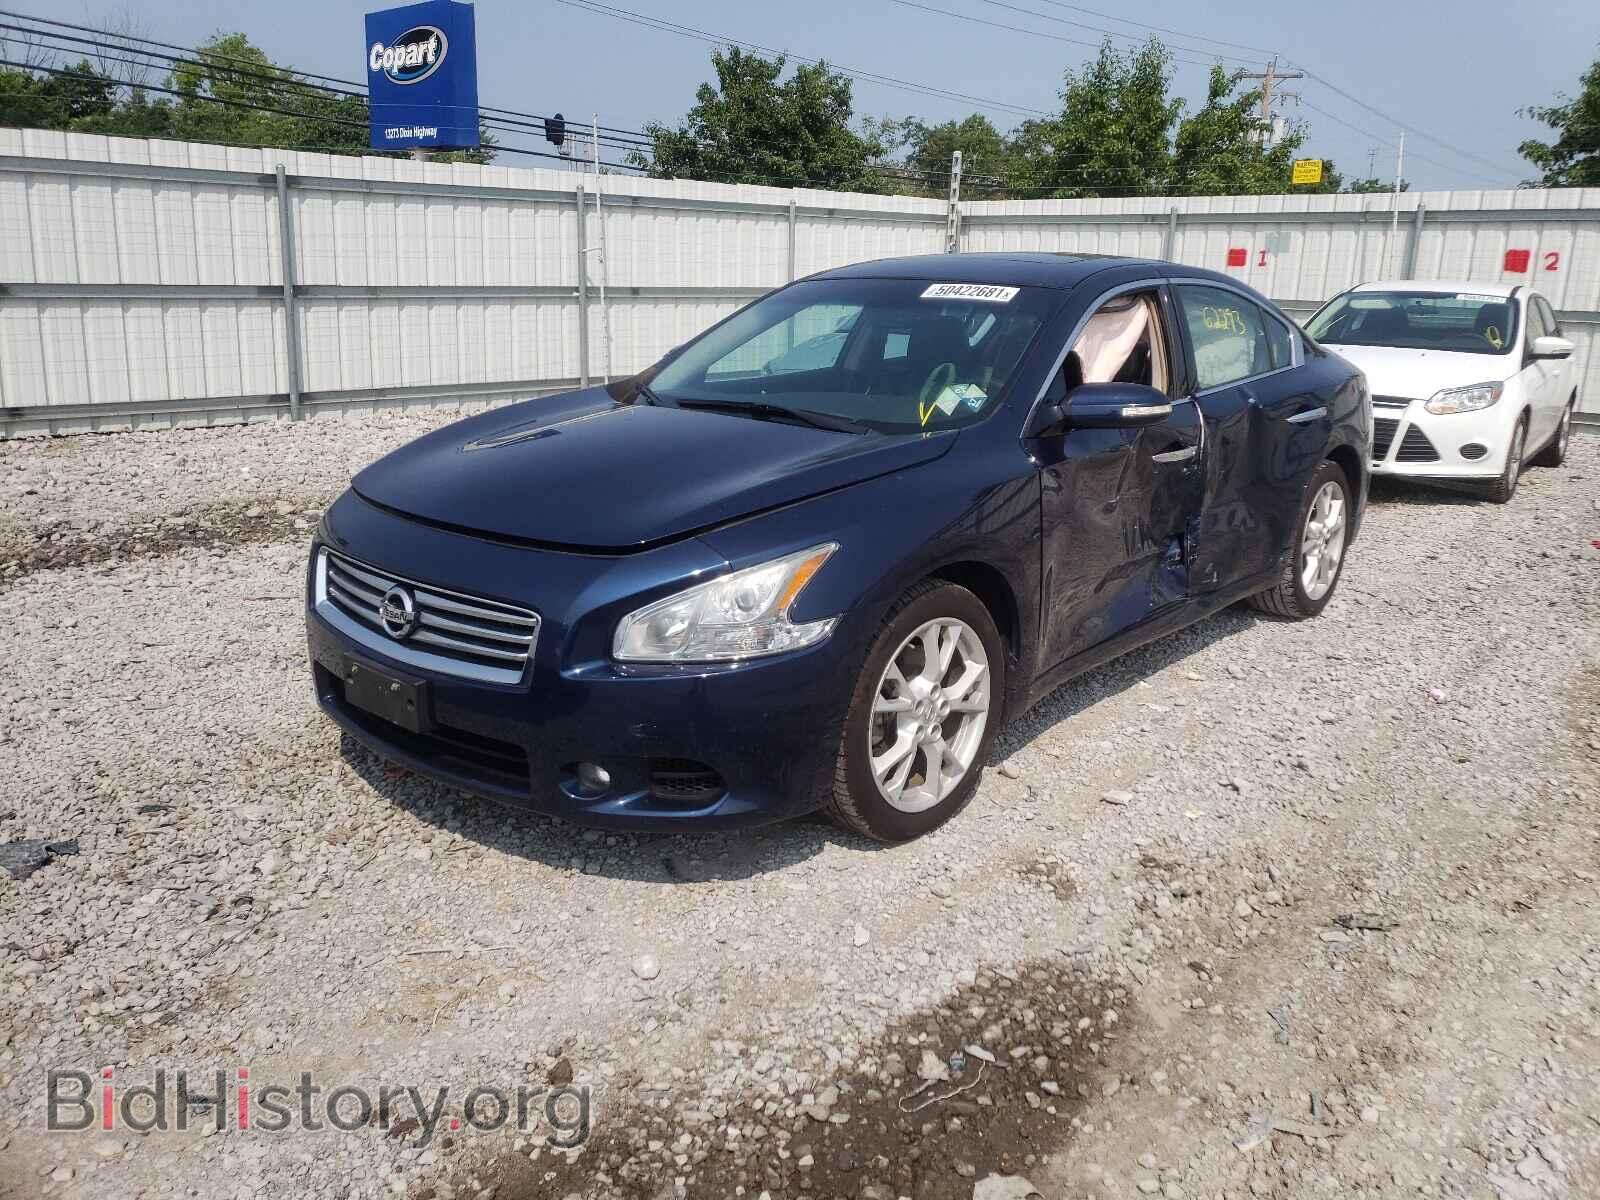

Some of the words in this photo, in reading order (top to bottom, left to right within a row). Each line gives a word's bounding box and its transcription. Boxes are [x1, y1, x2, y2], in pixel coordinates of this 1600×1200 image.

[370, 33, 438, 75] Copart
[384, 128, 399, 139] 13273
[400, 127, 413, 138] Dixie
[413, 126, 438, 139] Highway
[1258, 250, 1267, 266] 1
[1544, 252, 1559, 270] 2
[934, 284, 1005, 298] 50422681
